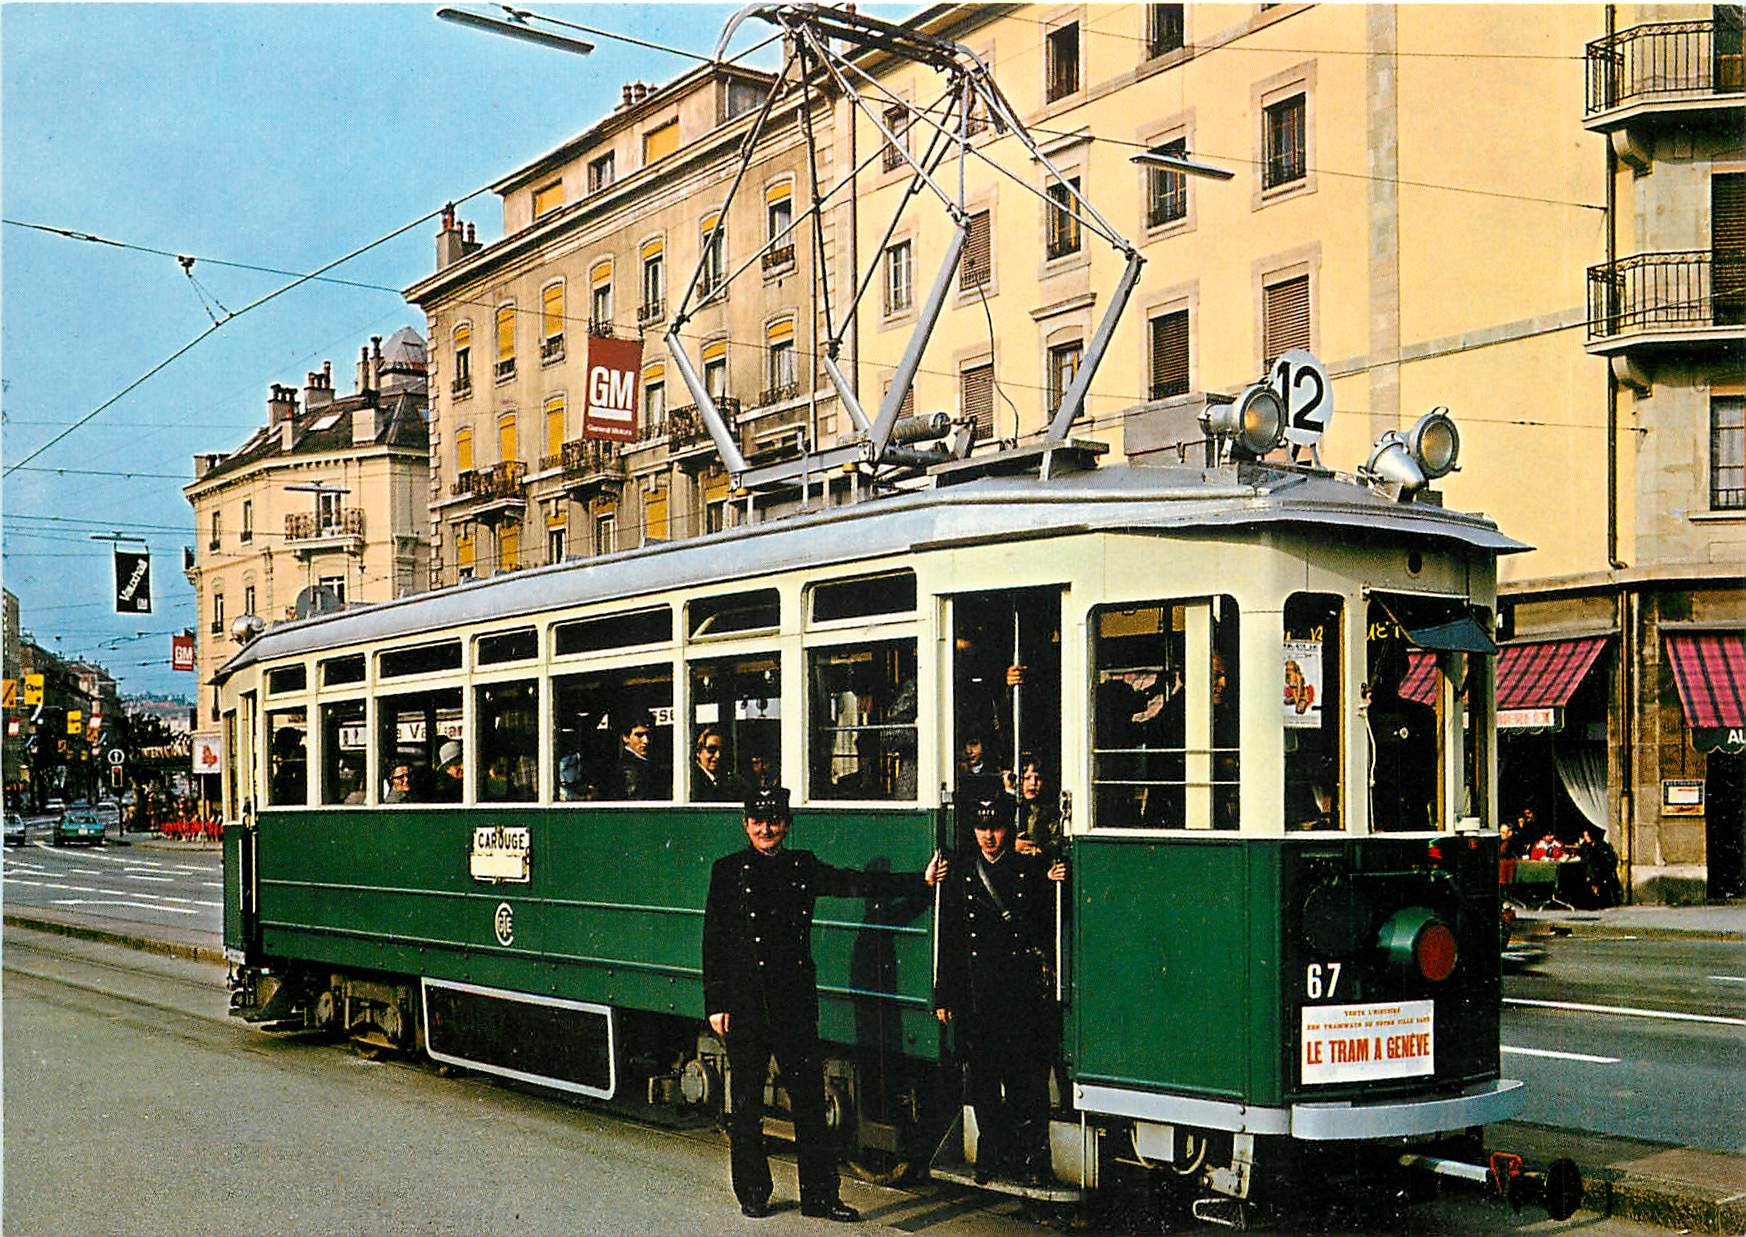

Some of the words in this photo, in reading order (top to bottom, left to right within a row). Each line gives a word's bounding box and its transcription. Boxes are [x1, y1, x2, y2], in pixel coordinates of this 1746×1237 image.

[590, 366, 634, 410] GM
[1277, 361, 1324, 433] 12
[119, 559, 148, 601] Vauxhall
[175, 646, 193, 661] GM
[478, 832, 525, 850] CAROUGE
[1307, 962, 1341, 999] 67
[1306, 1041, 1323, 1065] LE
[1328, 1038, 1370, 1064] TRAM
[1374, 1037, 1383, 1060] A
